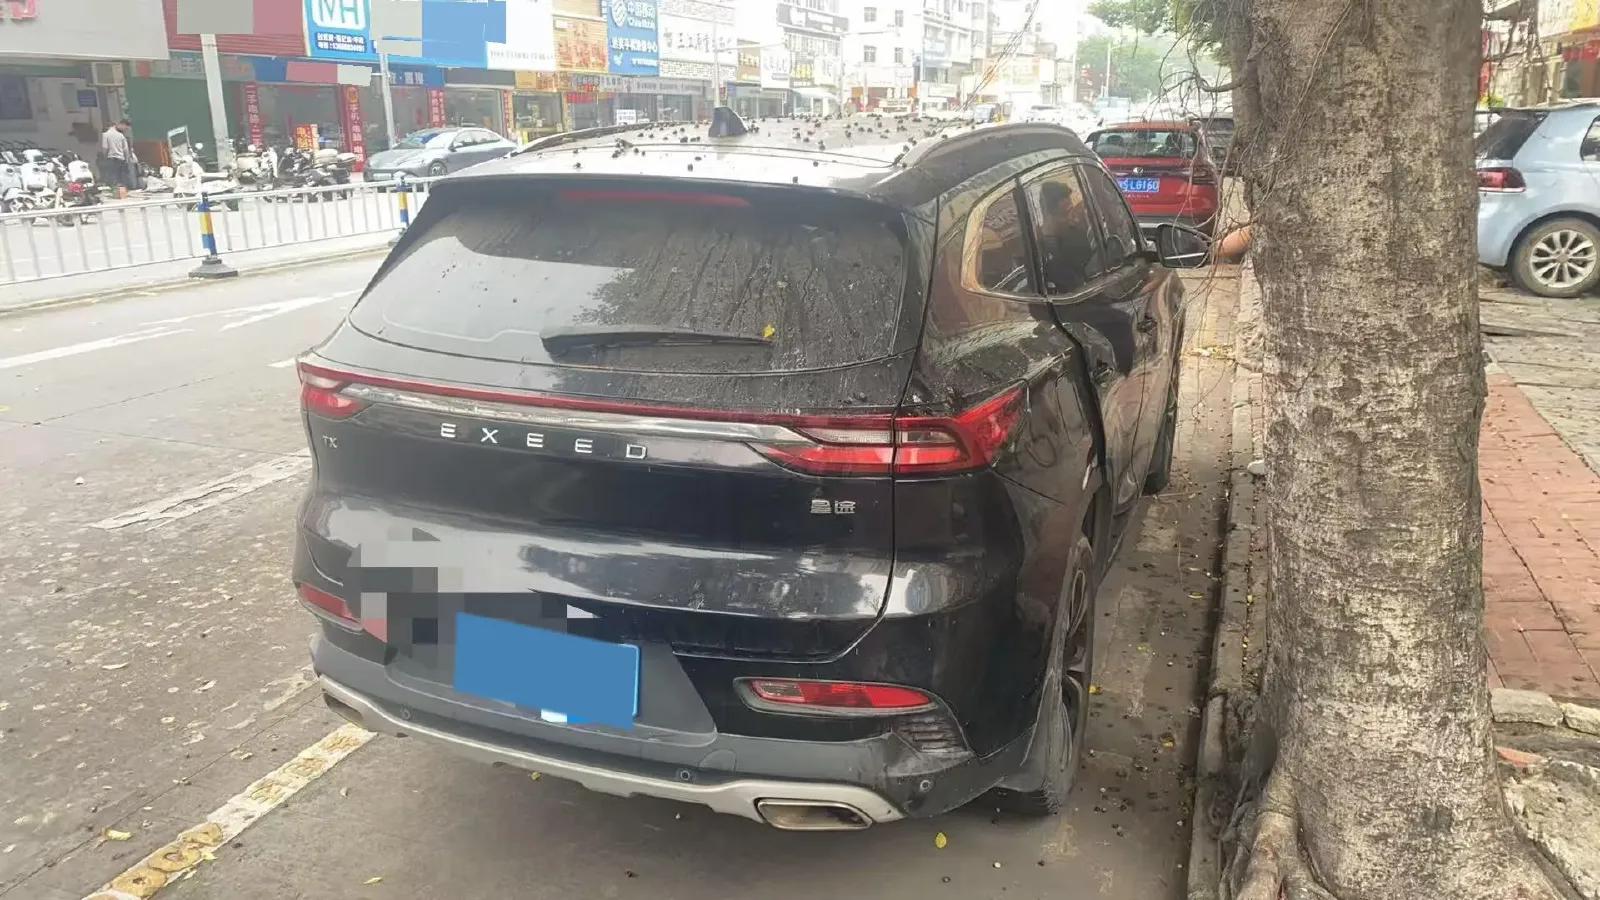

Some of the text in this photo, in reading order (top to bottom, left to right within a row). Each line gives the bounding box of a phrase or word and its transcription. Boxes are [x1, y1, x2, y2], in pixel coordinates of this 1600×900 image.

[627, 1, 656, 19] 中国移动
[322, 435, 338, 449] TX
[440, 422, 647, 460] EXEED
[811, 499, 856, 515] 星途
